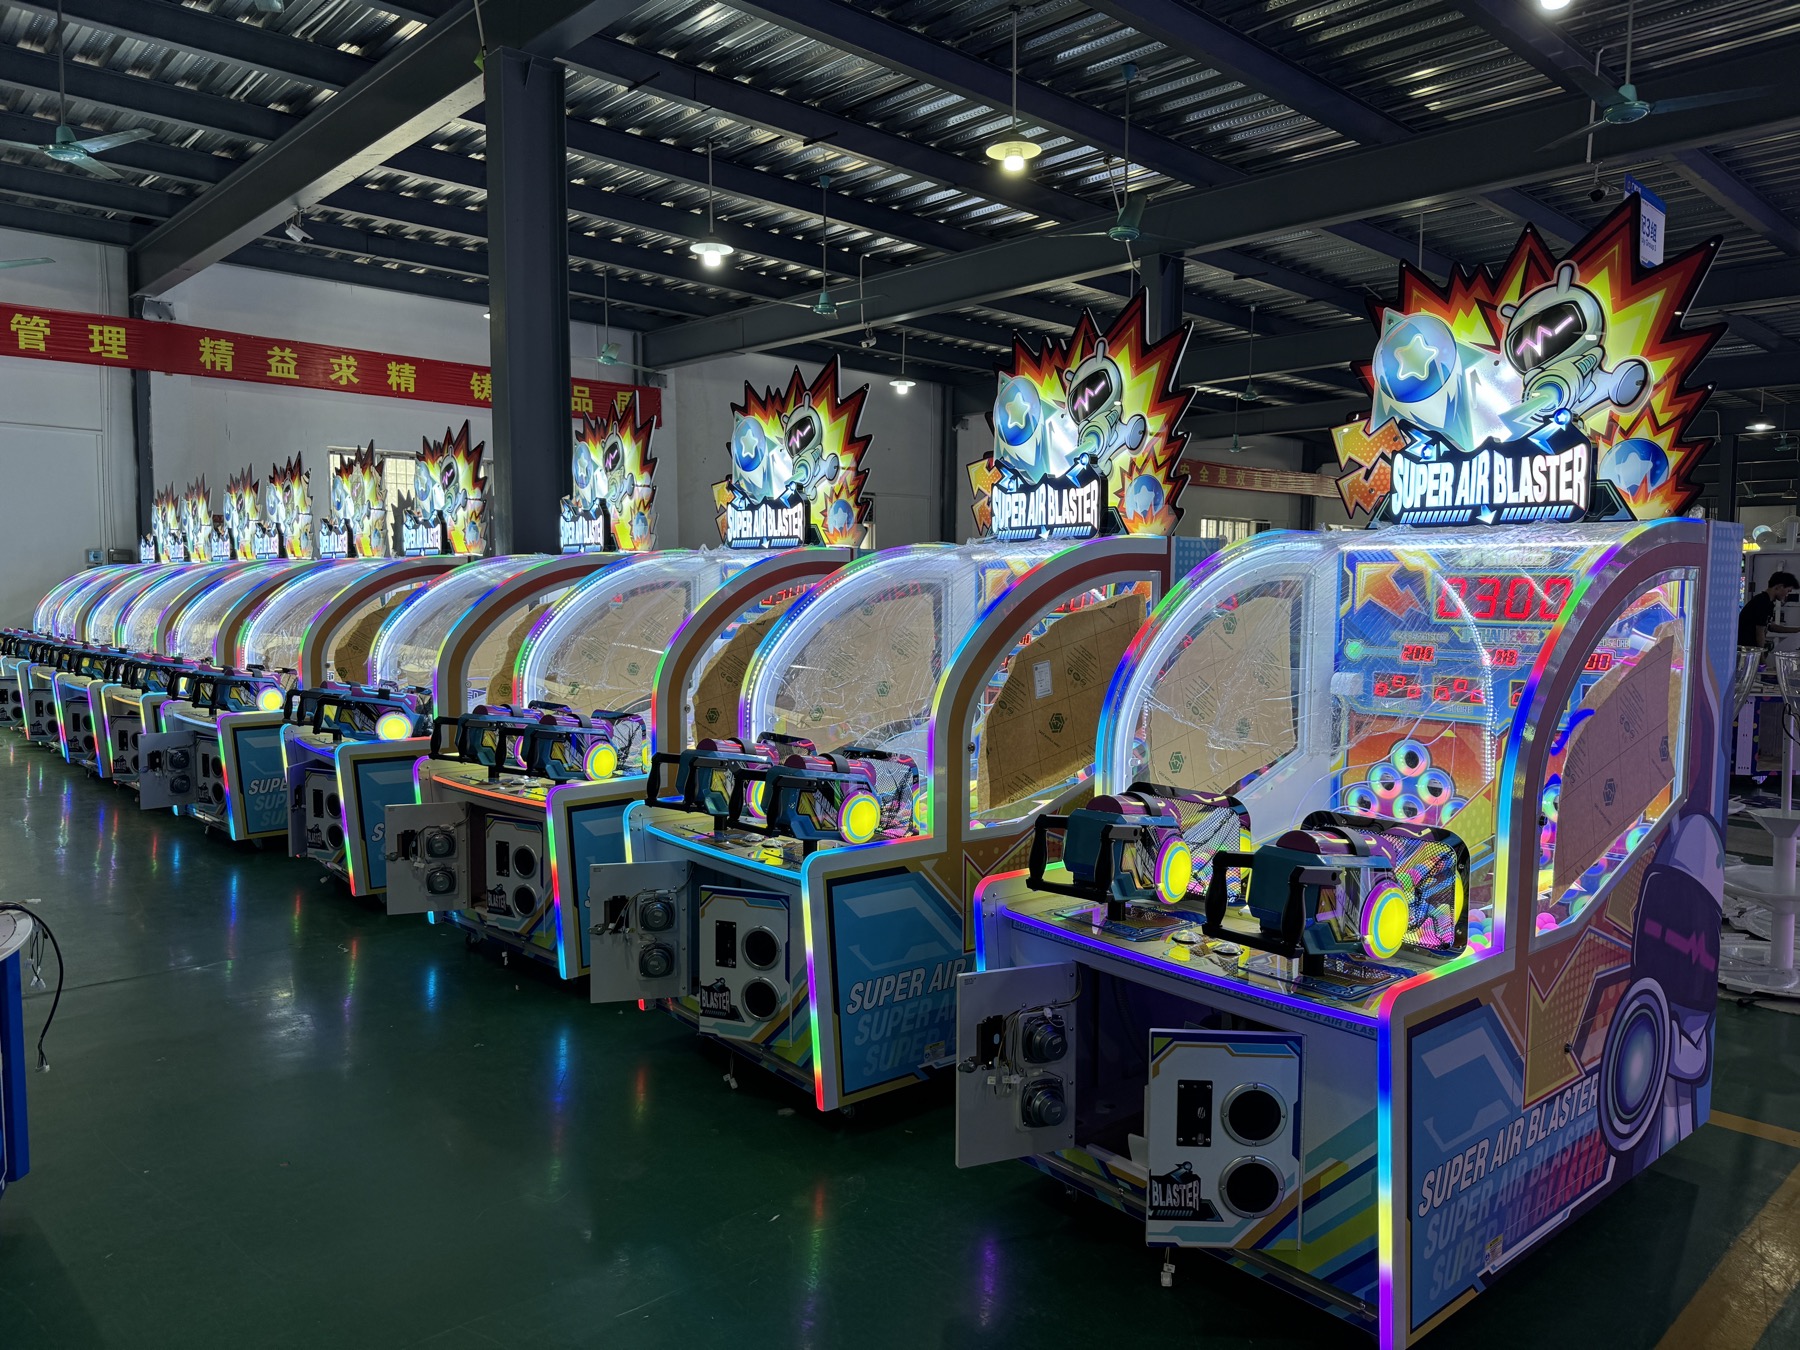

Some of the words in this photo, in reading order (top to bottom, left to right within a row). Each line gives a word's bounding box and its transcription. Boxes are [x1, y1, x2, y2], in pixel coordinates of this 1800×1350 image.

[10, 313, 129, 360] 管理
[199, 336, 417, 393] 精益求精
[1392, 453, 1455, 516] SUPER
[1454, 449, 1491, 506] AIR
[1493, 443, 1587, 511] BLASTER
[727, 503, 753, 542] SUPER
[752, 503, 767, 538] AIR
[766, 502, 803, 541] BLASTER
[992, 485, 1027, 534] SUPER
[1026, 483, 1047, 526] AIR
[1047, 479, 1099, 529] BLASTER
[702, 987, 730, 1014] BLASTER
[846, 967, 926, 1015] SUPER
[1418, 1137, 1490, 1218] SUPER
[1489, 1116, 1525, 1174] AIR
[1525, 1072, 1599, 1151] BLASTER
[1151, 1179, 1200, 1212] BLASTER
